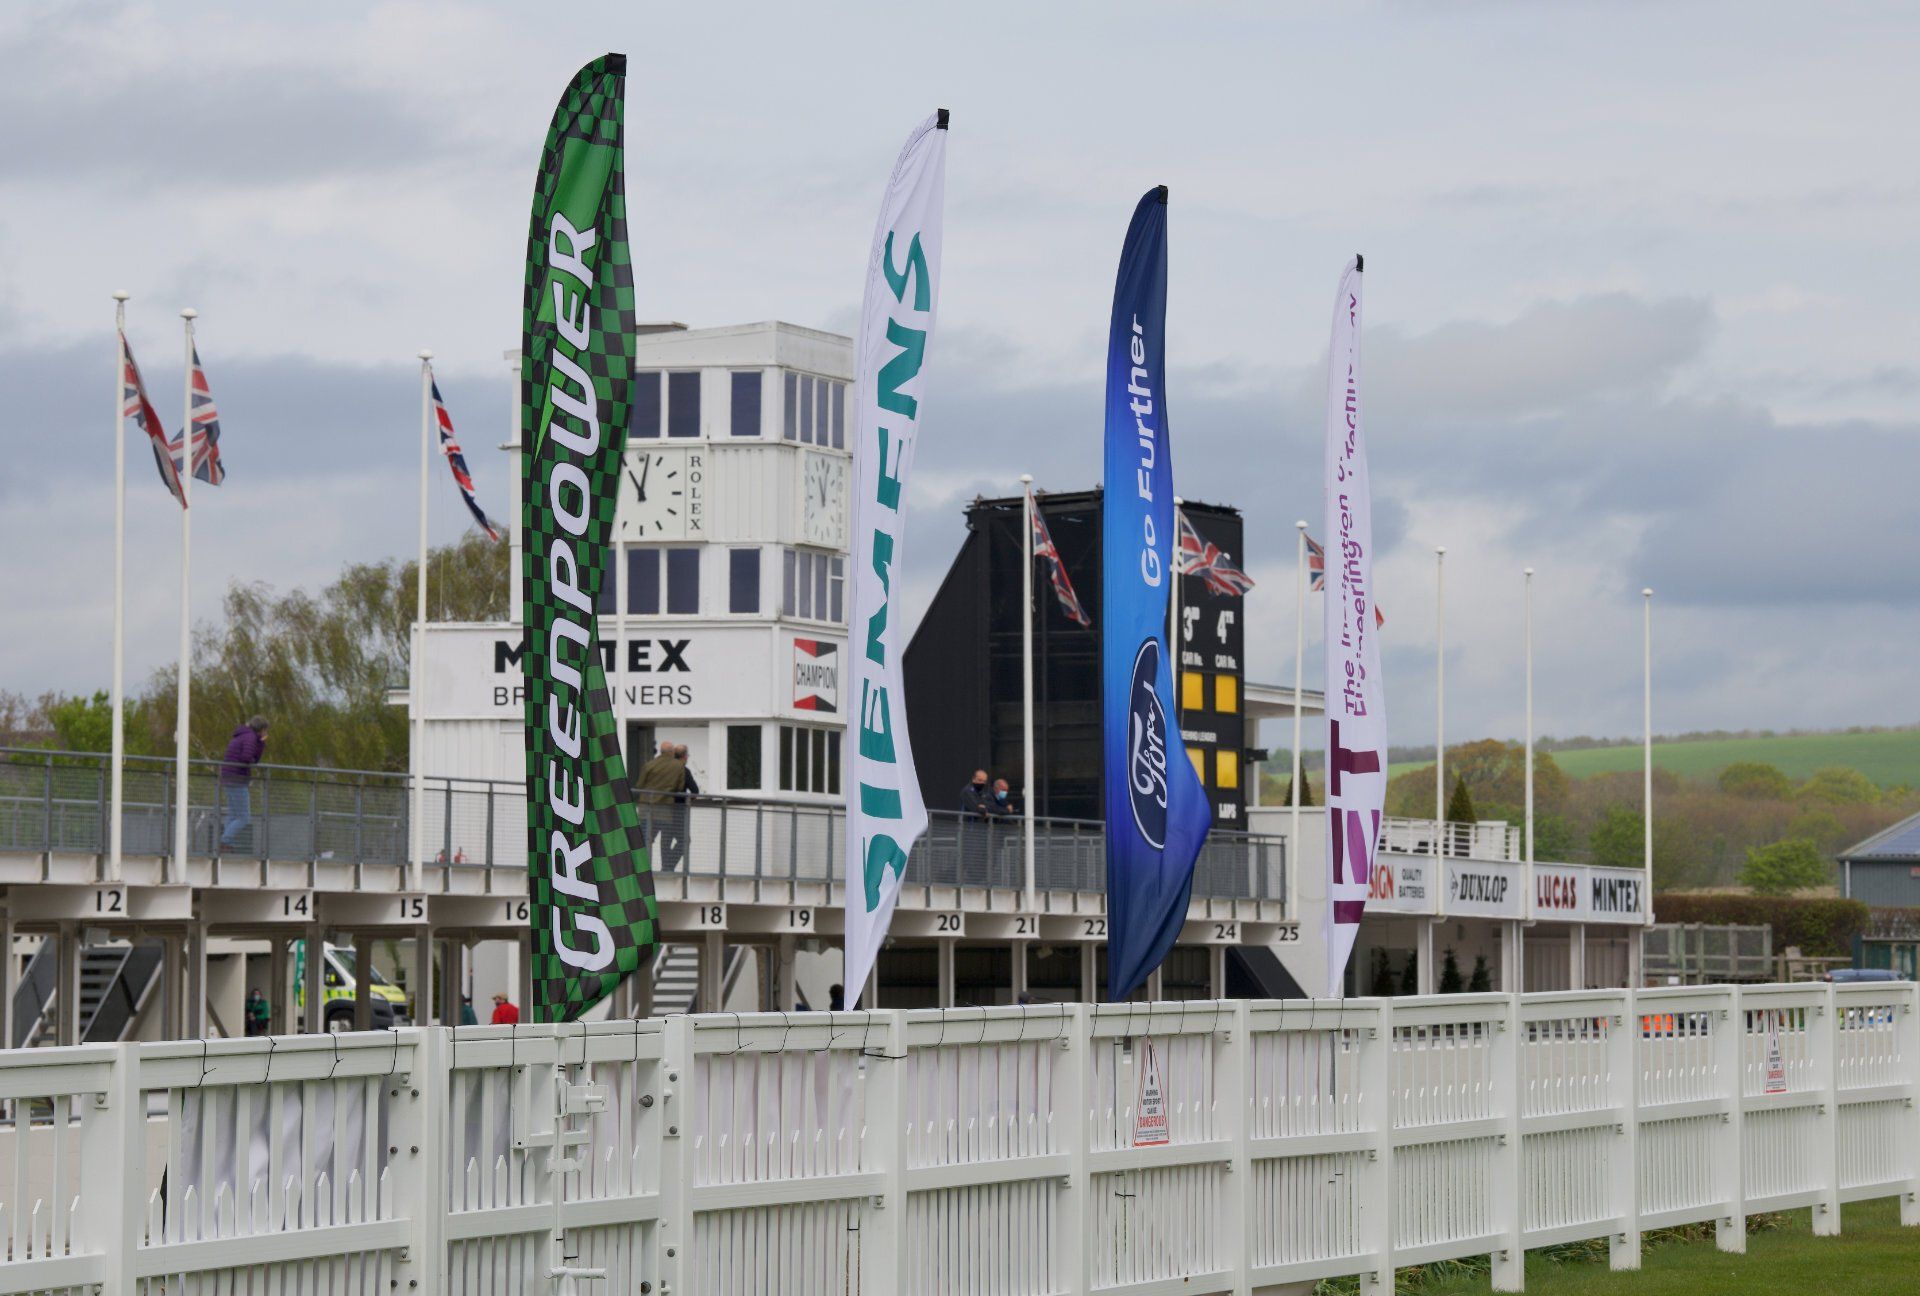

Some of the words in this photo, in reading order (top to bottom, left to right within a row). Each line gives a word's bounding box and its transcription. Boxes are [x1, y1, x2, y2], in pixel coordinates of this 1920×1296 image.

[1127, 313, 1155, 503] Further
[690, 456, 702, 530] ROLEX
[1141, 514, 1161, 588] Go
[860, 231, 931, 913] SIEMENS
[548, 211, 616, 972] GREENPOWER
[495, 639, 691, 673] MTEX
[796, 663, 836, 690] CHAMPION
[1343, 660, 1355, 713] The
[611, 685, 692, 706] INERS
[1402, 868, 1422, 881] QUALITY
[1399, 886, 1425, 899] BATTERIES
[1460, 873, 1508, 903] DUNLOP
[1537, 874, 1577, 911] LUCAS
[1592, 877, 1642, 913] MINTEX
[97, 890, 121, 912] 12
[283, 895, 308, 916] 14
[401, 898, 424, 918] 15
[506, 901, 529, 921] 16
[701, 905, 722, 925] 18
[789, 908, 811, 928] 19
[937, 913, 962, 932] 20
[1016, 916, 1037, 935] 21
[1084, 918, 1106, 936] 22
[1215, 923, 1237, 941] 24
[1279, 926, 1299, 943] 25
